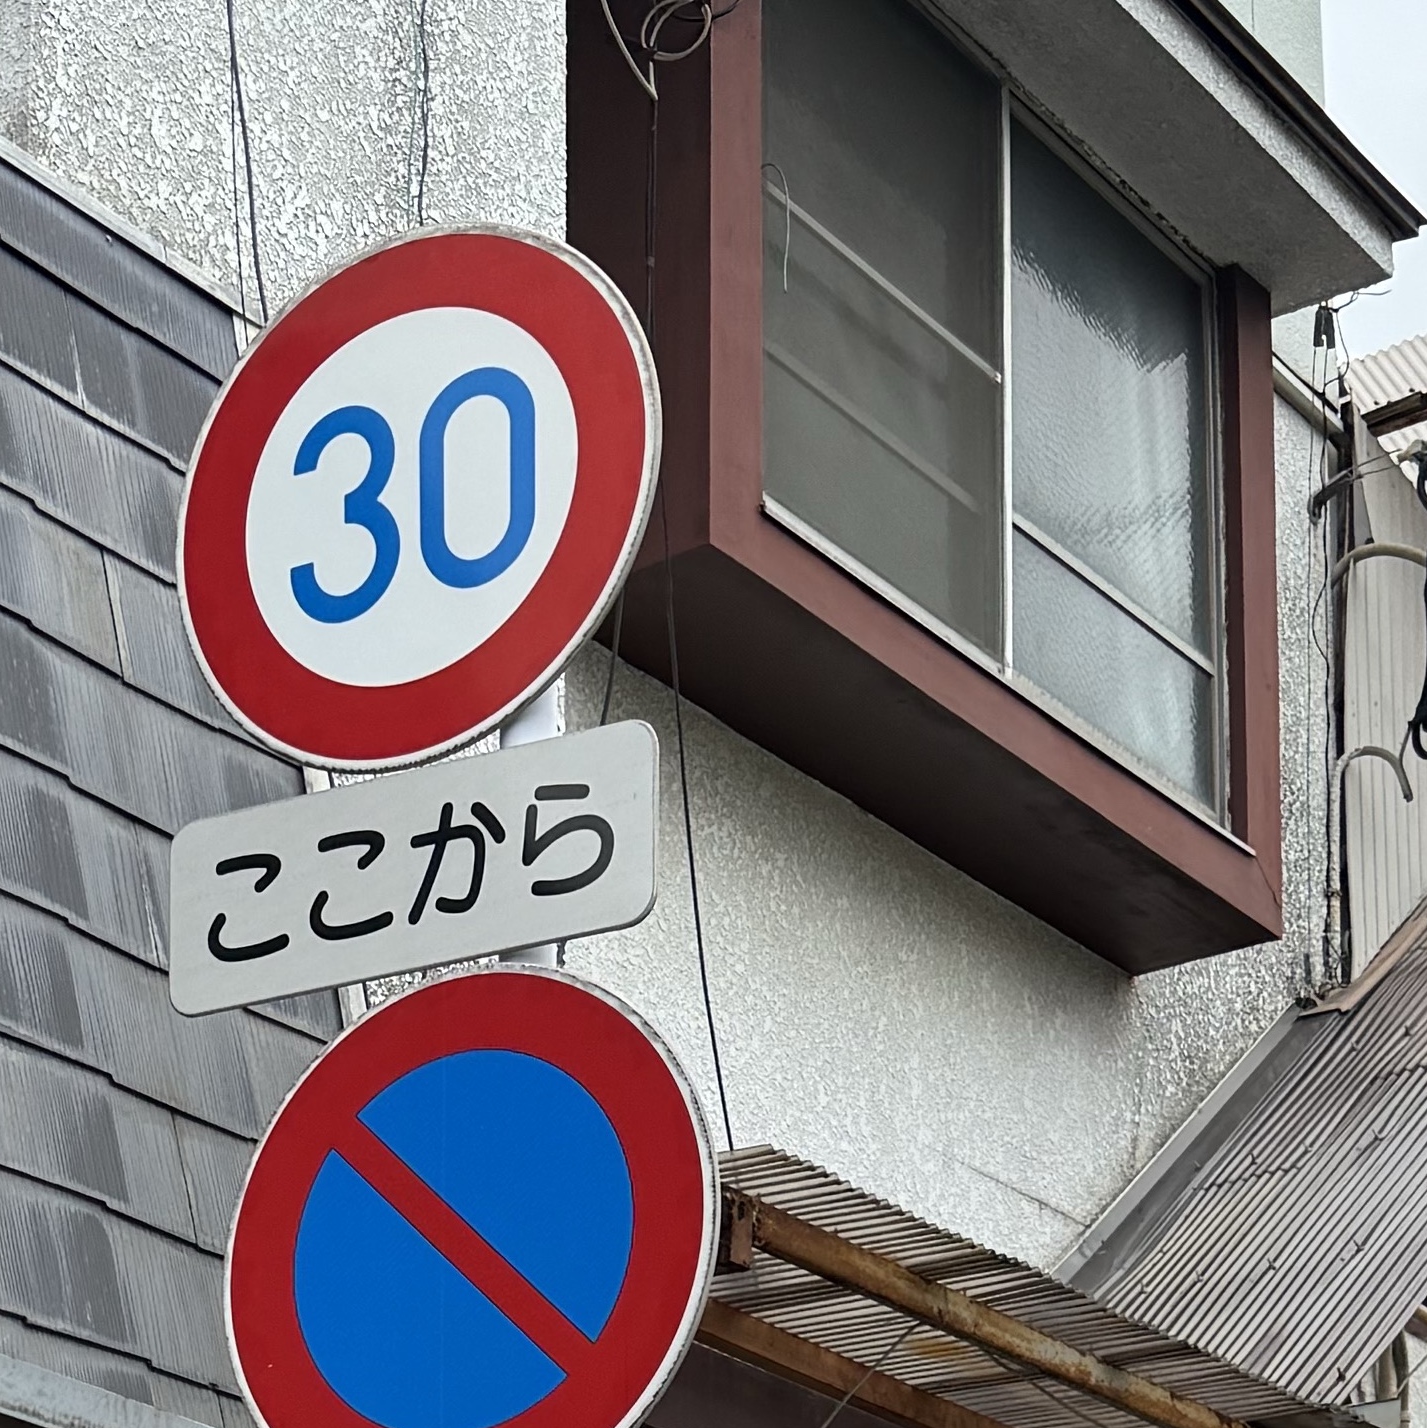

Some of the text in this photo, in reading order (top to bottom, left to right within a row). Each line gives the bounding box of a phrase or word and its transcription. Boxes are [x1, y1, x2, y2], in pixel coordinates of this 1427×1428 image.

[289, 365, 536, 625] 30
[207, 783, 615, 962] ここから
